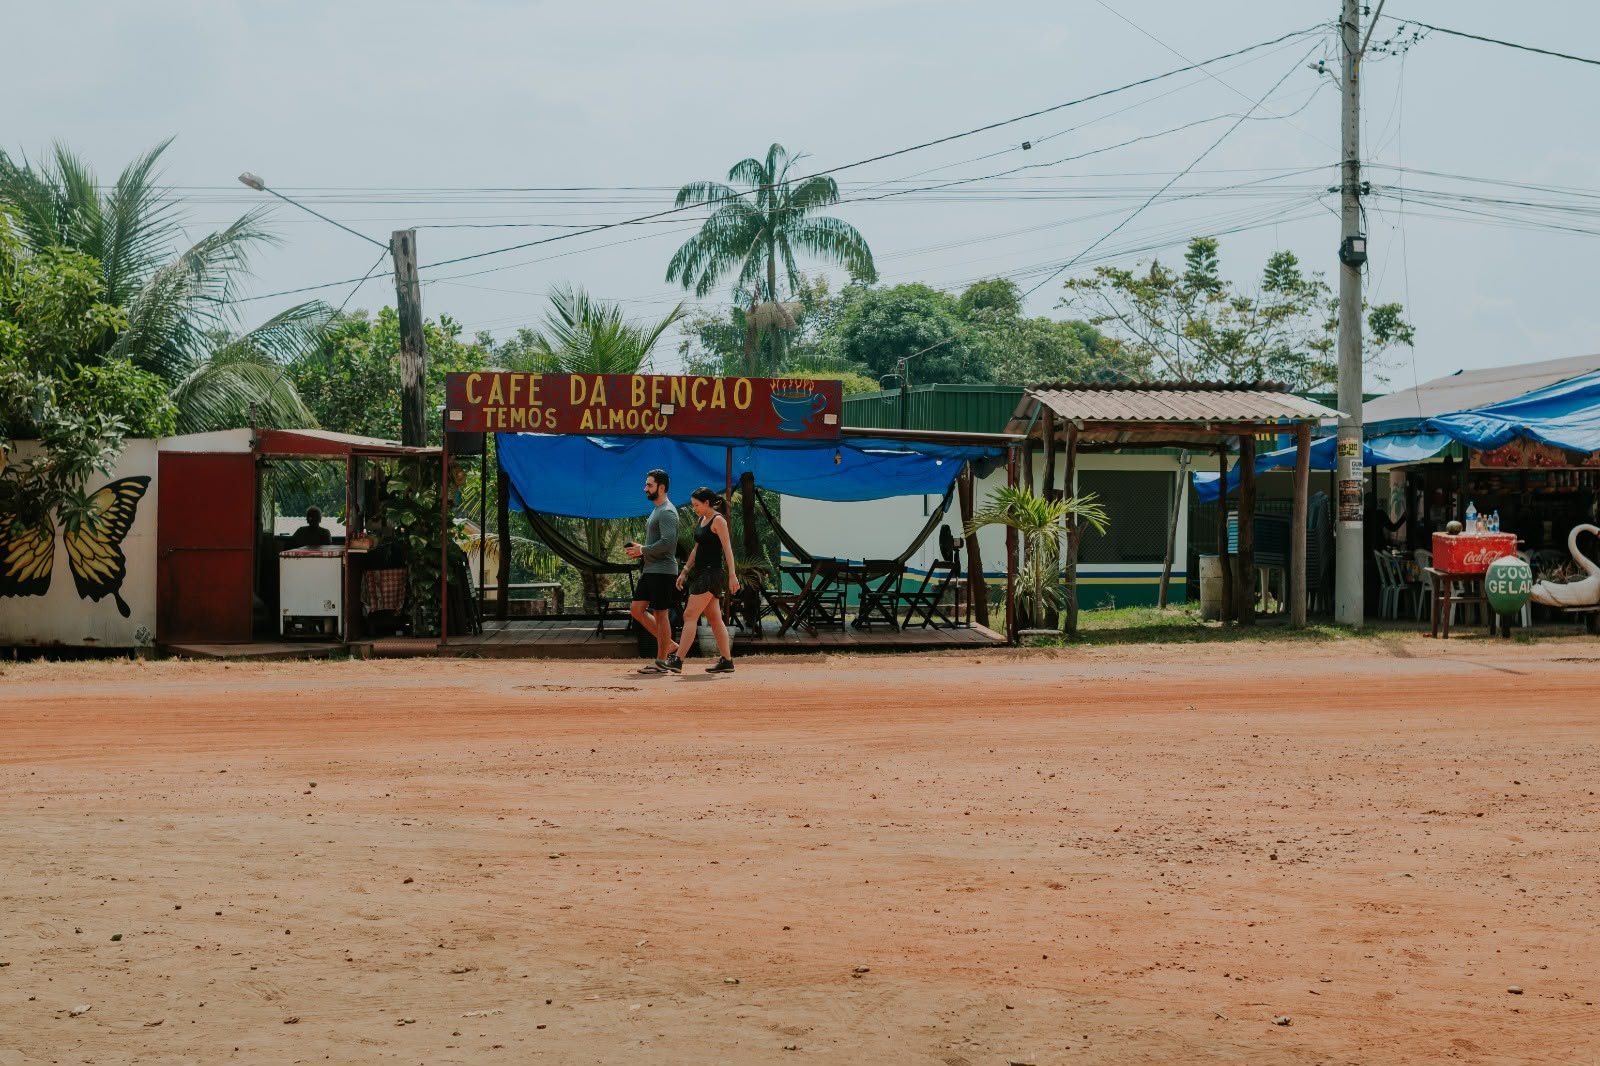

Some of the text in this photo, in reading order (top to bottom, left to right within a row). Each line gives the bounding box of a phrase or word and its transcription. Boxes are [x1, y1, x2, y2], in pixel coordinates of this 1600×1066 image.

[570, 374, 607, 406] DA
[482, 407, 668, 433] TEMOS ALMOÇO
